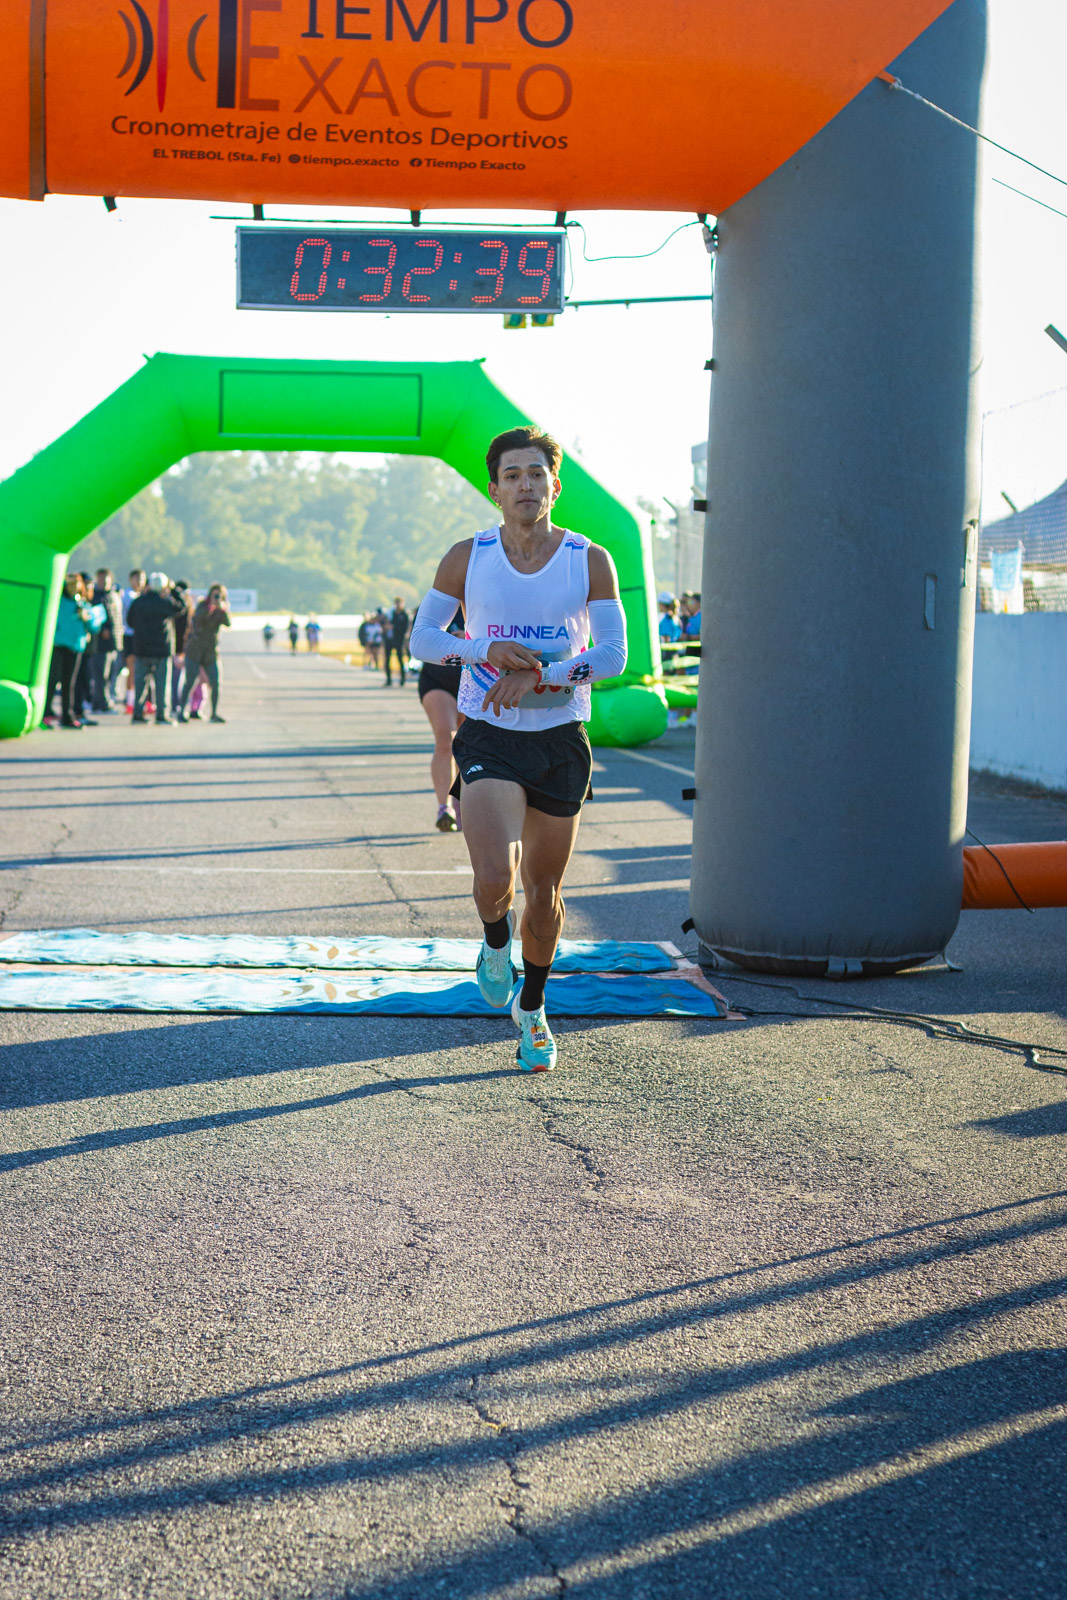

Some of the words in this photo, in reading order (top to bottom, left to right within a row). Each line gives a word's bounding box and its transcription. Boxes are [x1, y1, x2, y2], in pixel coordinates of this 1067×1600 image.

[111, 115, 280, 144] Cronometraje
[286, 121, 318, 142] de
[325, 123, 423, 146] Eventos
[430, 127, 569, 151] Deportivos
[152, 148, 169, 159] EL
[171, 149, 225, 161] TREBOL
[227, 151, 258, 163] (Sta.
[261, 153, 281, 164] Fe)
[424, 158, 477, 171] Tiempo
[480, 160, 526, 171] Exacto
[290, 238, 556, 304] 0:32:39
[487, 624, 570, 640] RUNNEA
